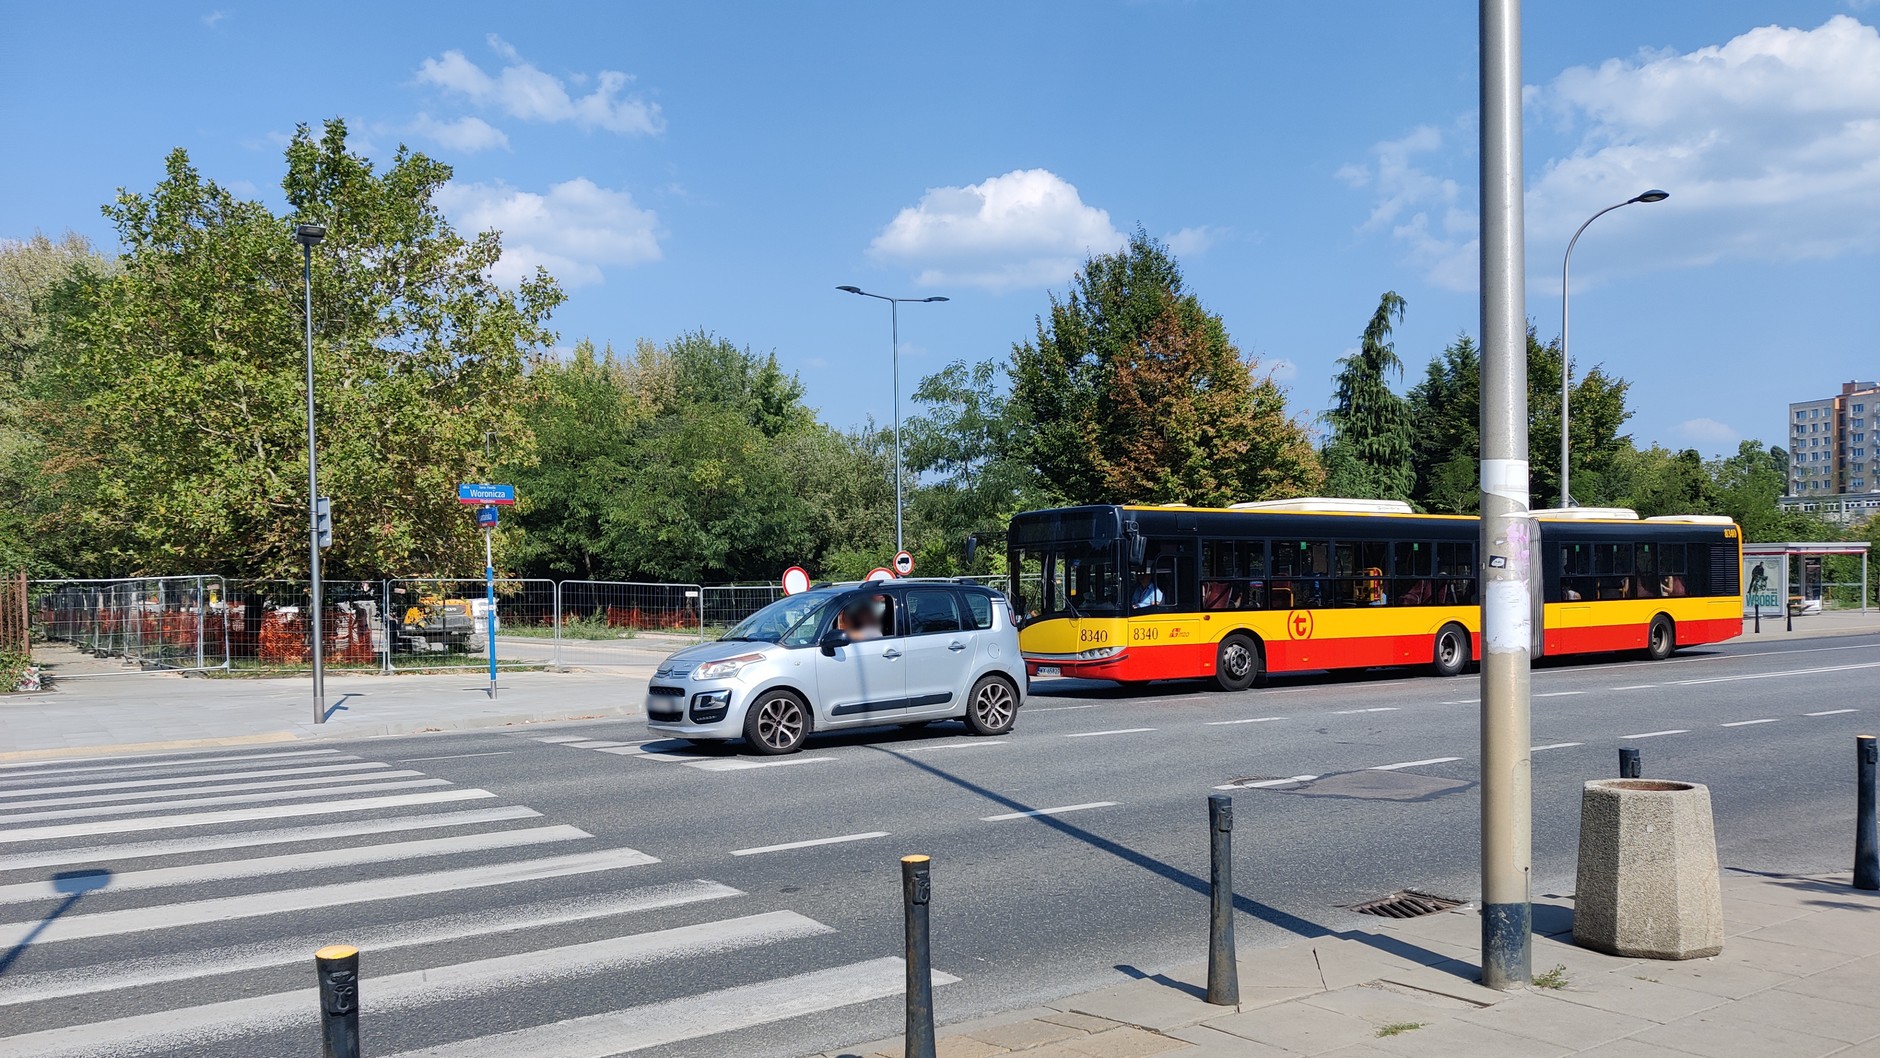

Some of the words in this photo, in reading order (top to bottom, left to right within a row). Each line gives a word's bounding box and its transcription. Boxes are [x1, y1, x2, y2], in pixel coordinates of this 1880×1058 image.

[470, 489, 506, 498] Woronicza
[1724, 529, 1737, 538] 8340
[1081, 629, 1108, 642] 8340
[1133, 627, 1159, 641] 8340
